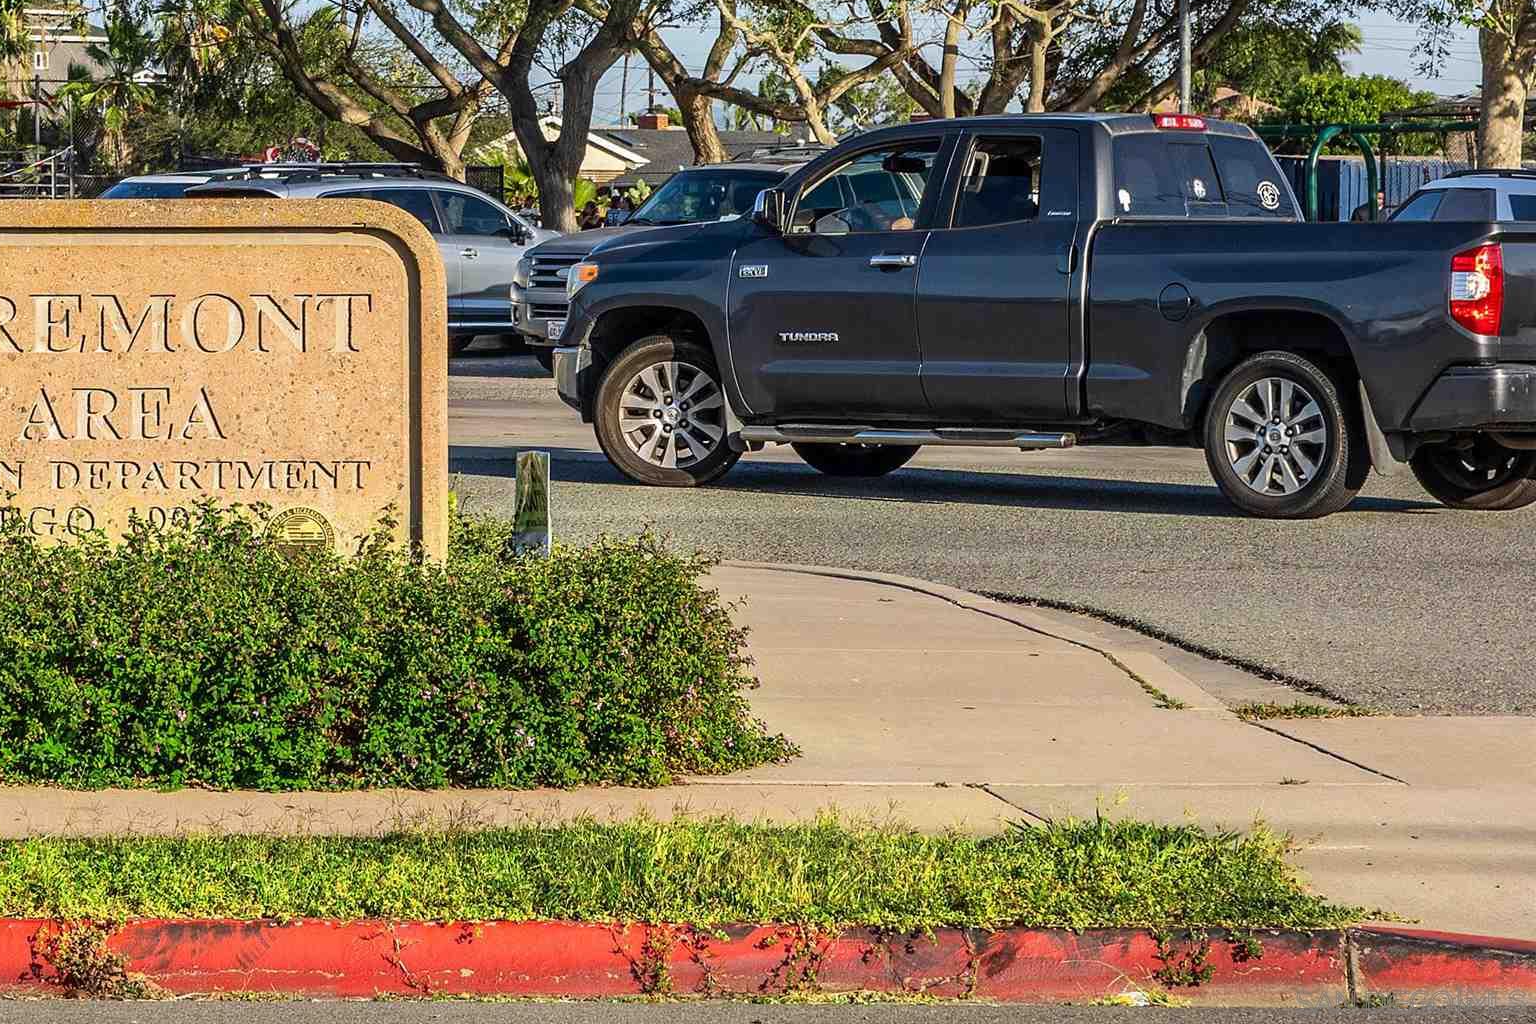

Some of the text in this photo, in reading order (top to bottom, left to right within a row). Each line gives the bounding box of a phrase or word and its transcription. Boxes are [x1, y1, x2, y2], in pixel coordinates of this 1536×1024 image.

[778, 332, 839, 342] TUNDRA
[20, 384, 227, 443] AREA
[49, 460, 371, 491] DEPARTMENT
